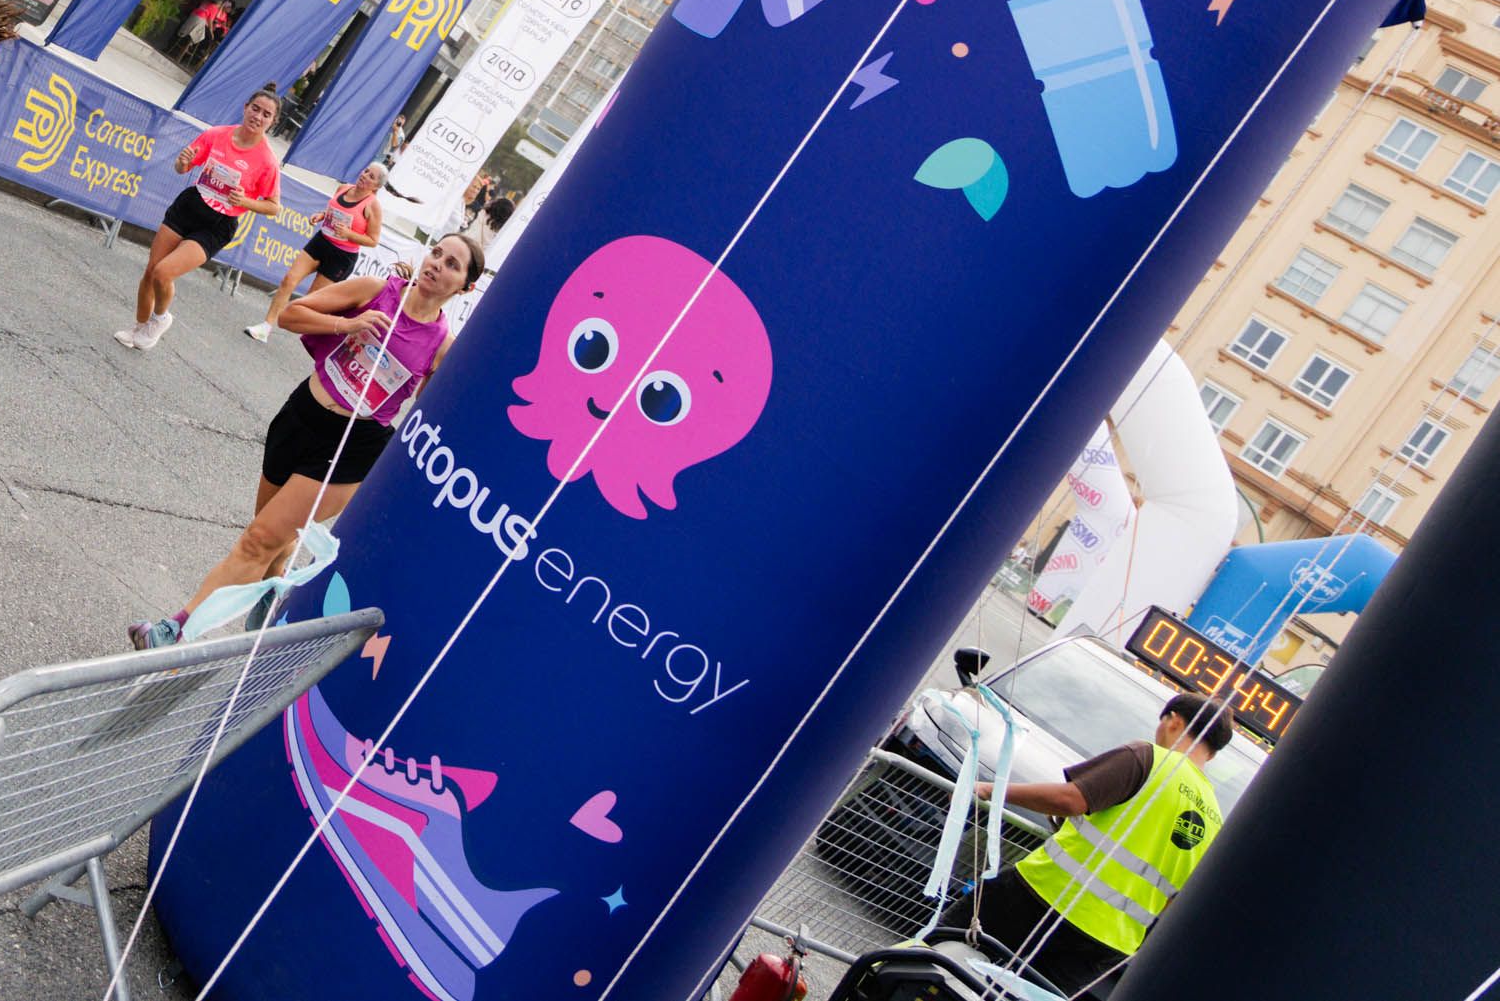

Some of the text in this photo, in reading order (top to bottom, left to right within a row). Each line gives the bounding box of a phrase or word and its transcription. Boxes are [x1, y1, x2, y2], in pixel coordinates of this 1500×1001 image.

[486, 53, 527, 83] ziaja
[85, 108, 156, 161] Correos
[432, 122, 476, 156] ziaja
[69, 144, 142, 198] Express
[253, 226, 301, 267] Expres
[1083, 448, 1117, 466] COSM
[400, 409, 750, 715] octopus energy
